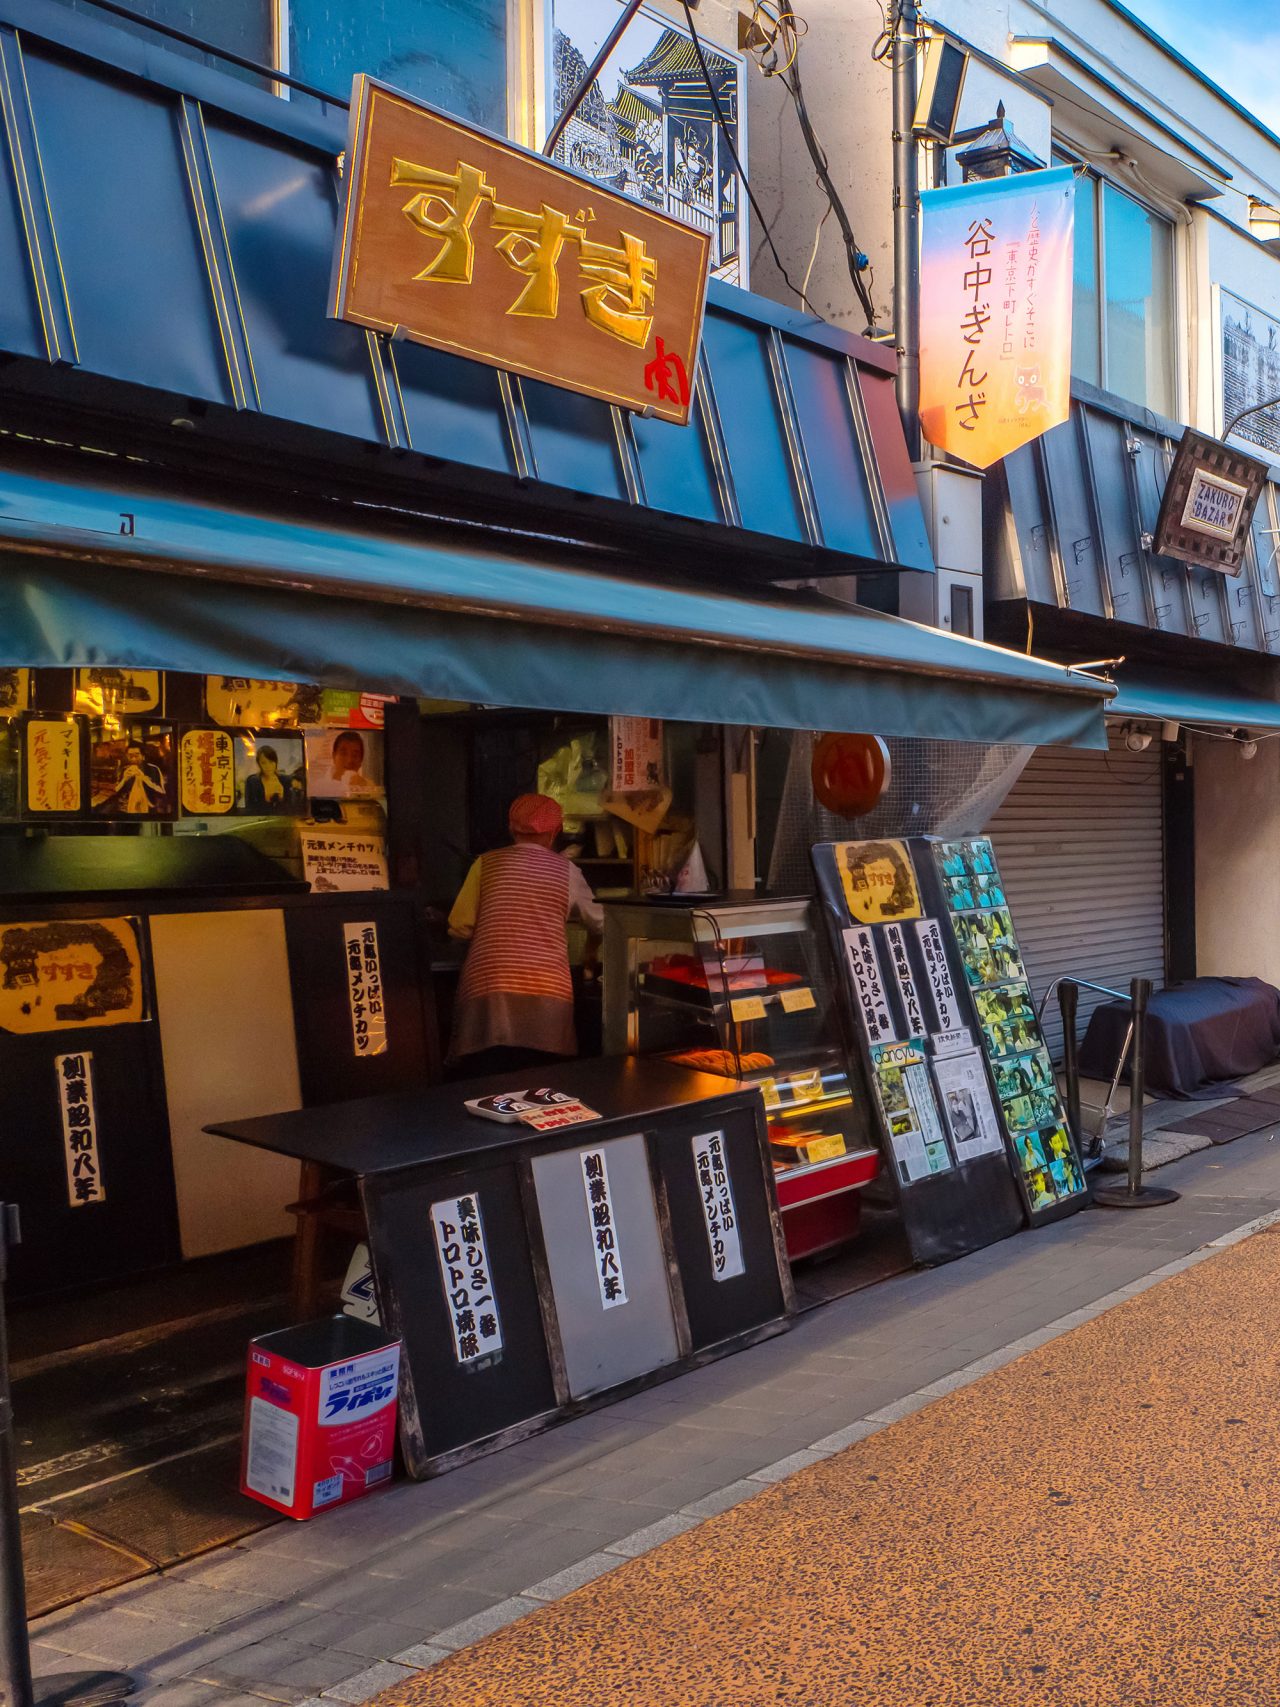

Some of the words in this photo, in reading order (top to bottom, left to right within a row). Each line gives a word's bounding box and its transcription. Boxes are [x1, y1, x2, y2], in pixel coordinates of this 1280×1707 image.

[390, 160, 658, 349] すずき
[955, 217, 995, 432] 谷中ぎんざ
[1195, 504, 1227, 526] BAZAR
[1198, 484, 1235, 510] ZAKURO
[347, 939, 369, 1050] 元気メンチカツ
[361, 927, 382, 1014] 元気いっぱい
[62, 1055, 98, 1200] 創業昭和八年
[708, 1136, 734, 1231] 元気いっぱい
[457, 1197, 496, 1338] 美味しさ一番
[584, 1153, 622, 1300] 創業昭和八年
[697, 1151, 726, 1272] 元気メンチカツ
